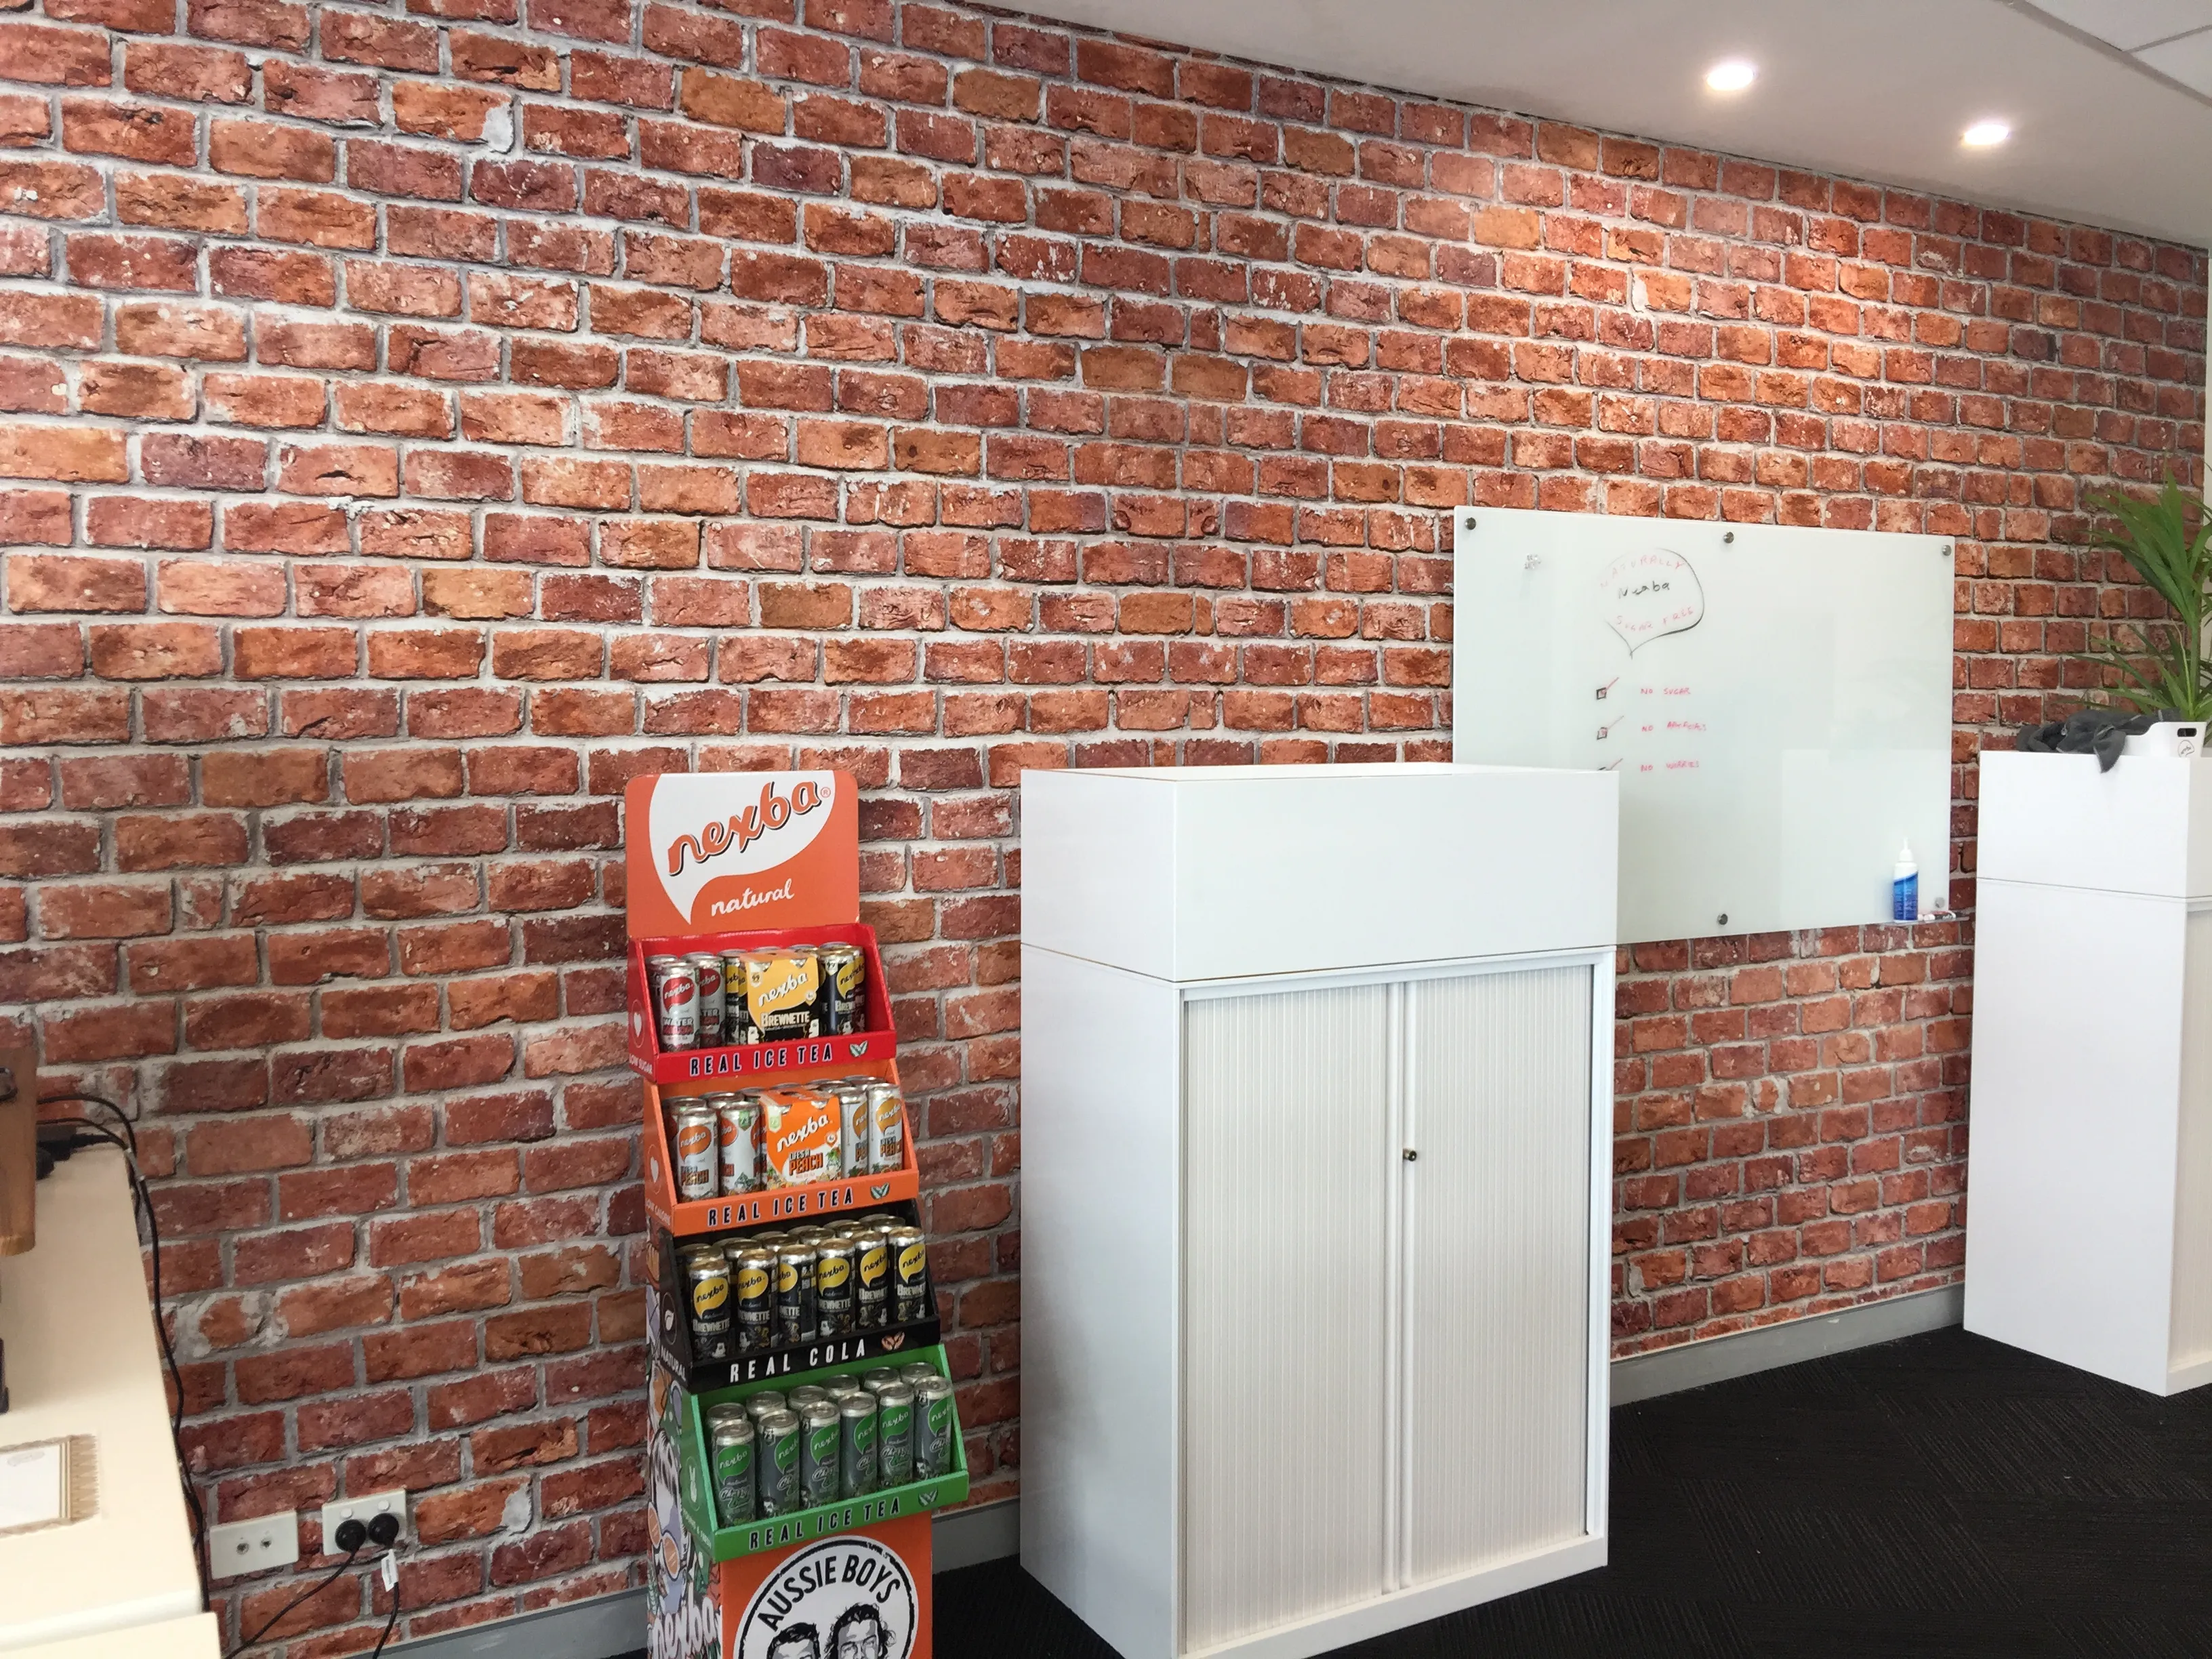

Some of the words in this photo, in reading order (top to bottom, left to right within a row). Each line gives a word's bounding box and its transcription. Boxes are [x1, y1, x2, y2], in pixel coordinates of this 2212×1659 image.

[1663, 687, 1692, 695] SUGAR
[1640, 764, 1654, 773] NO
[710, 878, 795, 918] natural
[758, 972, 808, 1008] nexba
[760, 1010, 811, 1028] BREWNETTE
[689, 1052, 742, 1078] REAL
[752, 1046, 787, 1069] ICE
[797, 1042, 834, 1065] TEA
[776, 1113, 829, 1152] nexba
[789, 1152, 823, 1176] PEACH
[708, 1201, 761, 1227] REAL
[773, 1193, 806, 1217] ICE
[817, 1186, 855, 1208] TEA
[660, 1345, 687, 1382] NATURAL
[729, 1353, 791, 1383] REAL
[809, 1339, 866, 1368] COLA
[749, 1521, 803, 1550] REAL
[817, 1512, 852, 1532] ICE
[864, 1502, 901, 1523] TEA
[757, 1555, 836, 1633] AUSSIE
[842, 1553, 901, 1604] BOYS
